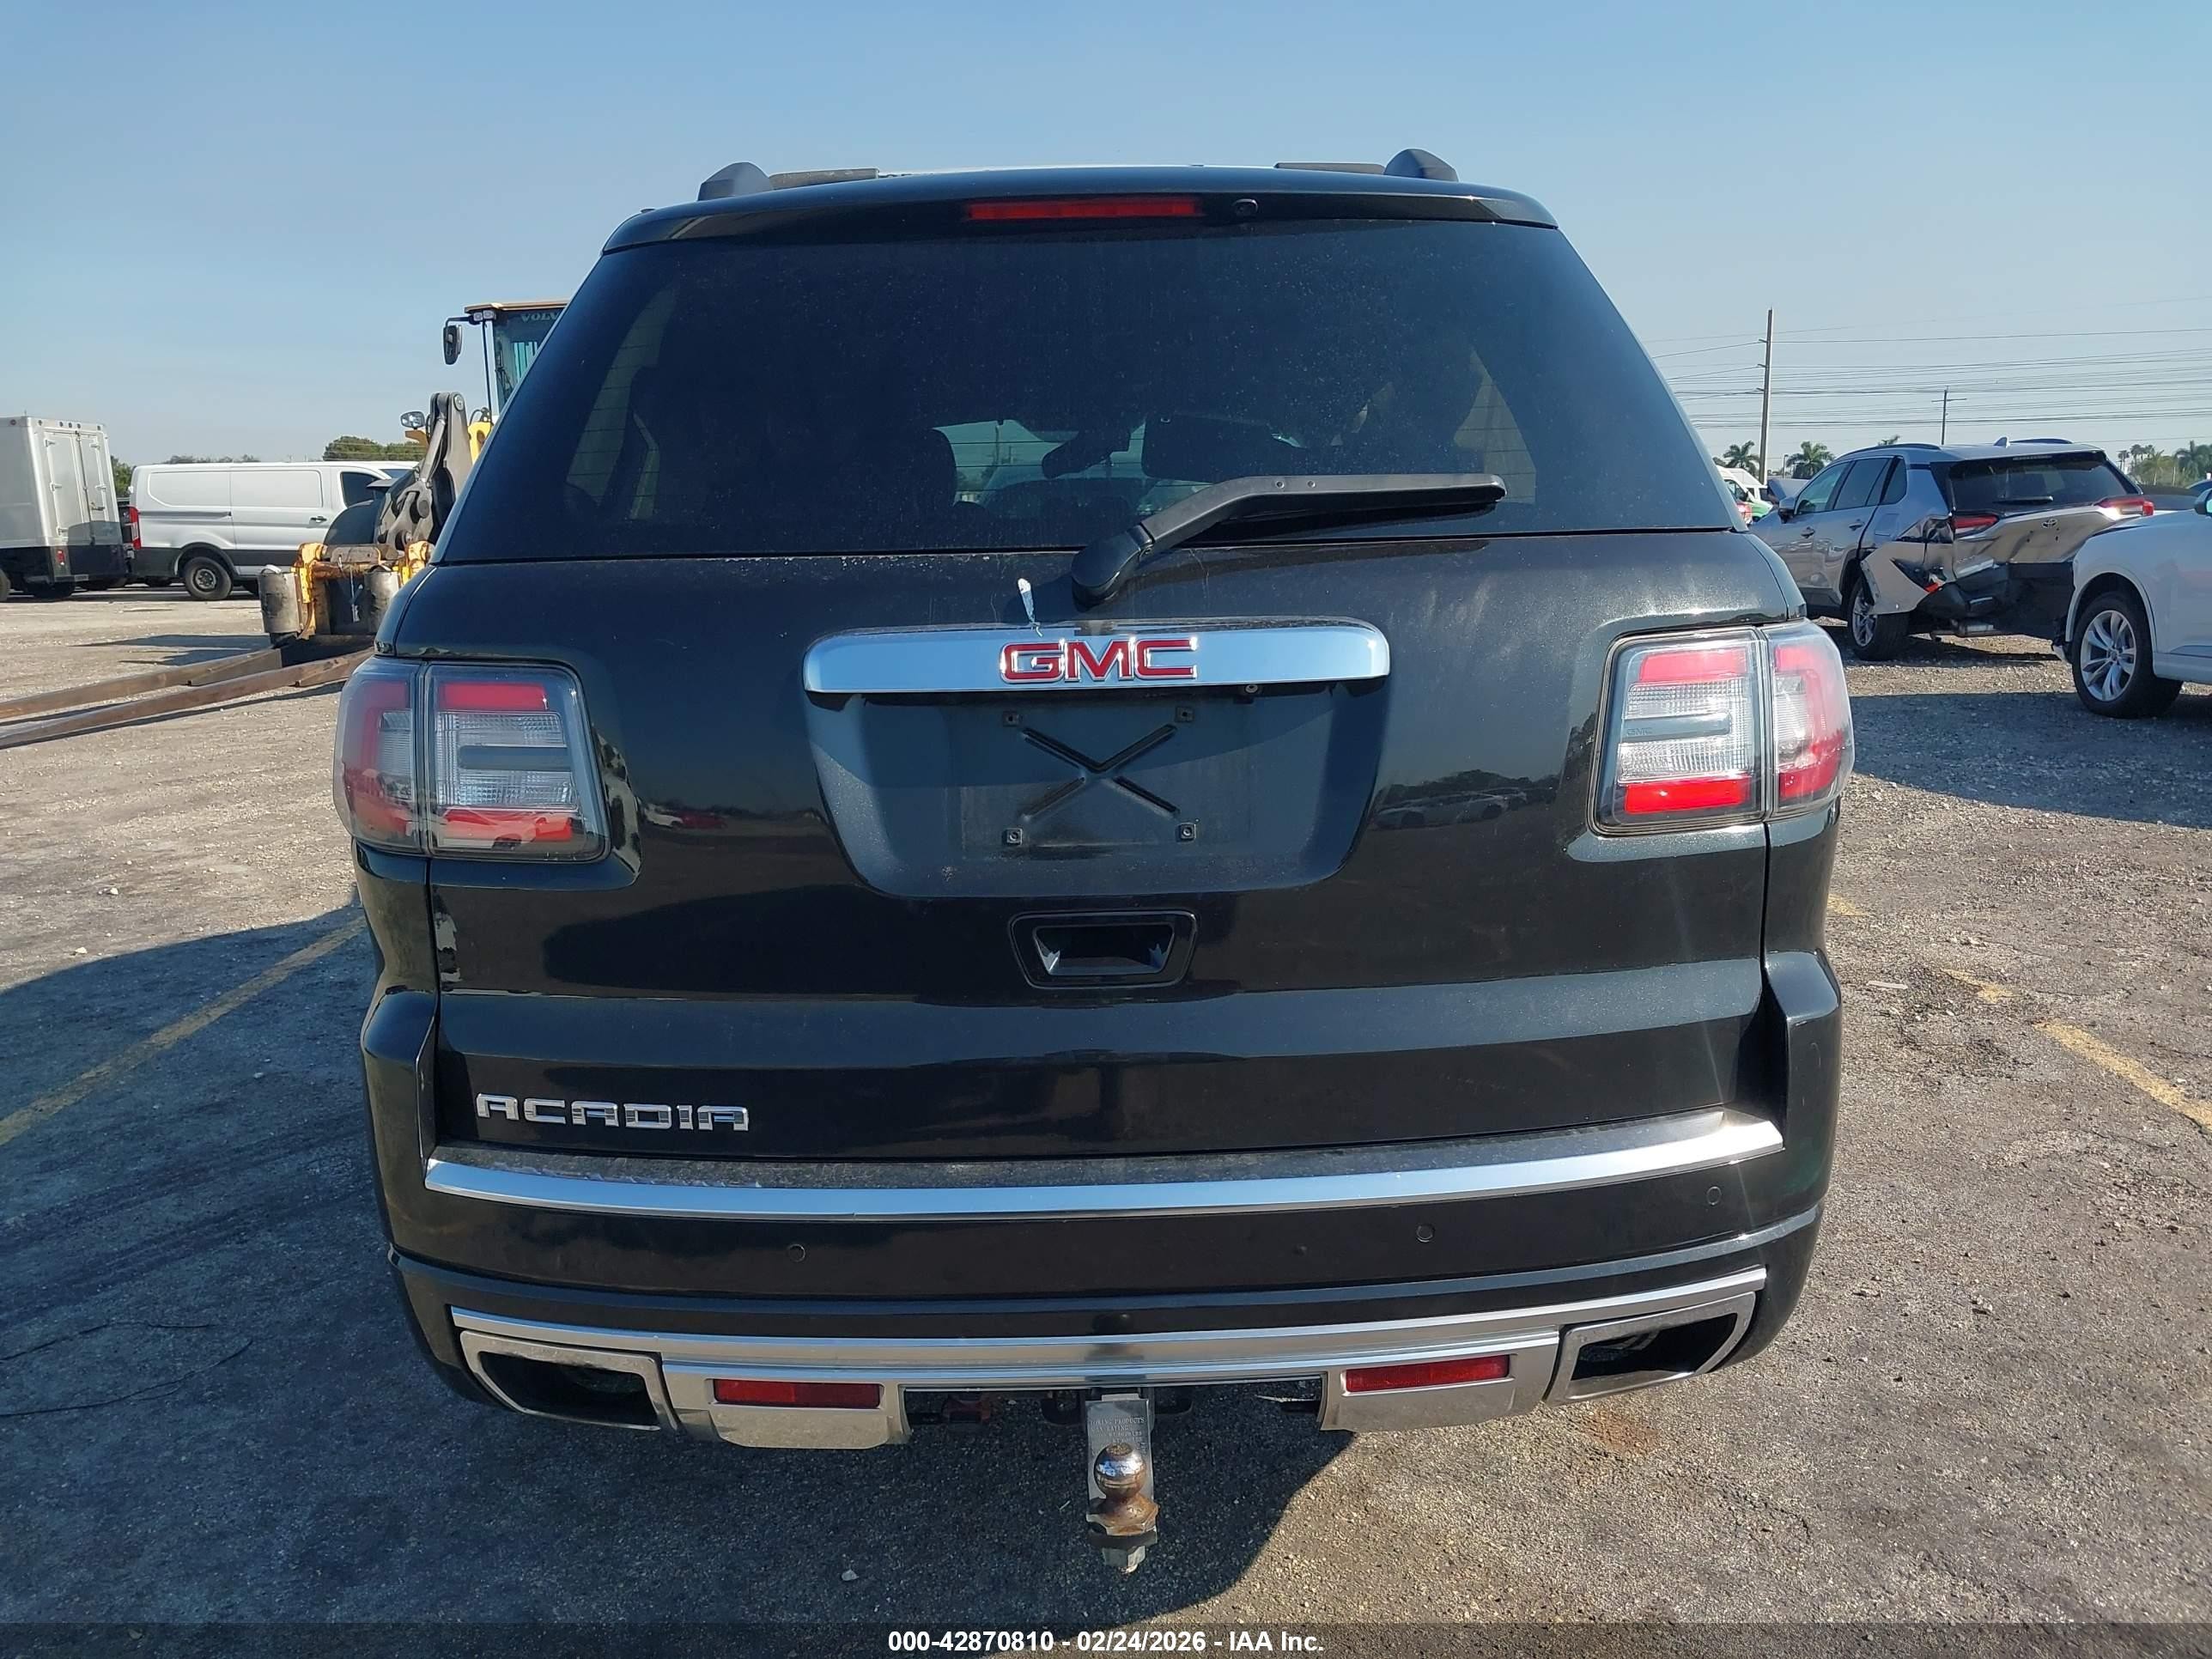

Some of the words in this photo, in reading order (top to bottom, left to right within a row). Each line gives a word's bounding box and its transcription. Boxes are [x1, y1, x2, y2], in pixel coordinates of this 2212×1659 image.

[521, 312, 559, 322] VOLV
[1000, 635, 1198, 684] GMC
[475, 1092, 750, 1132] ACADIA
